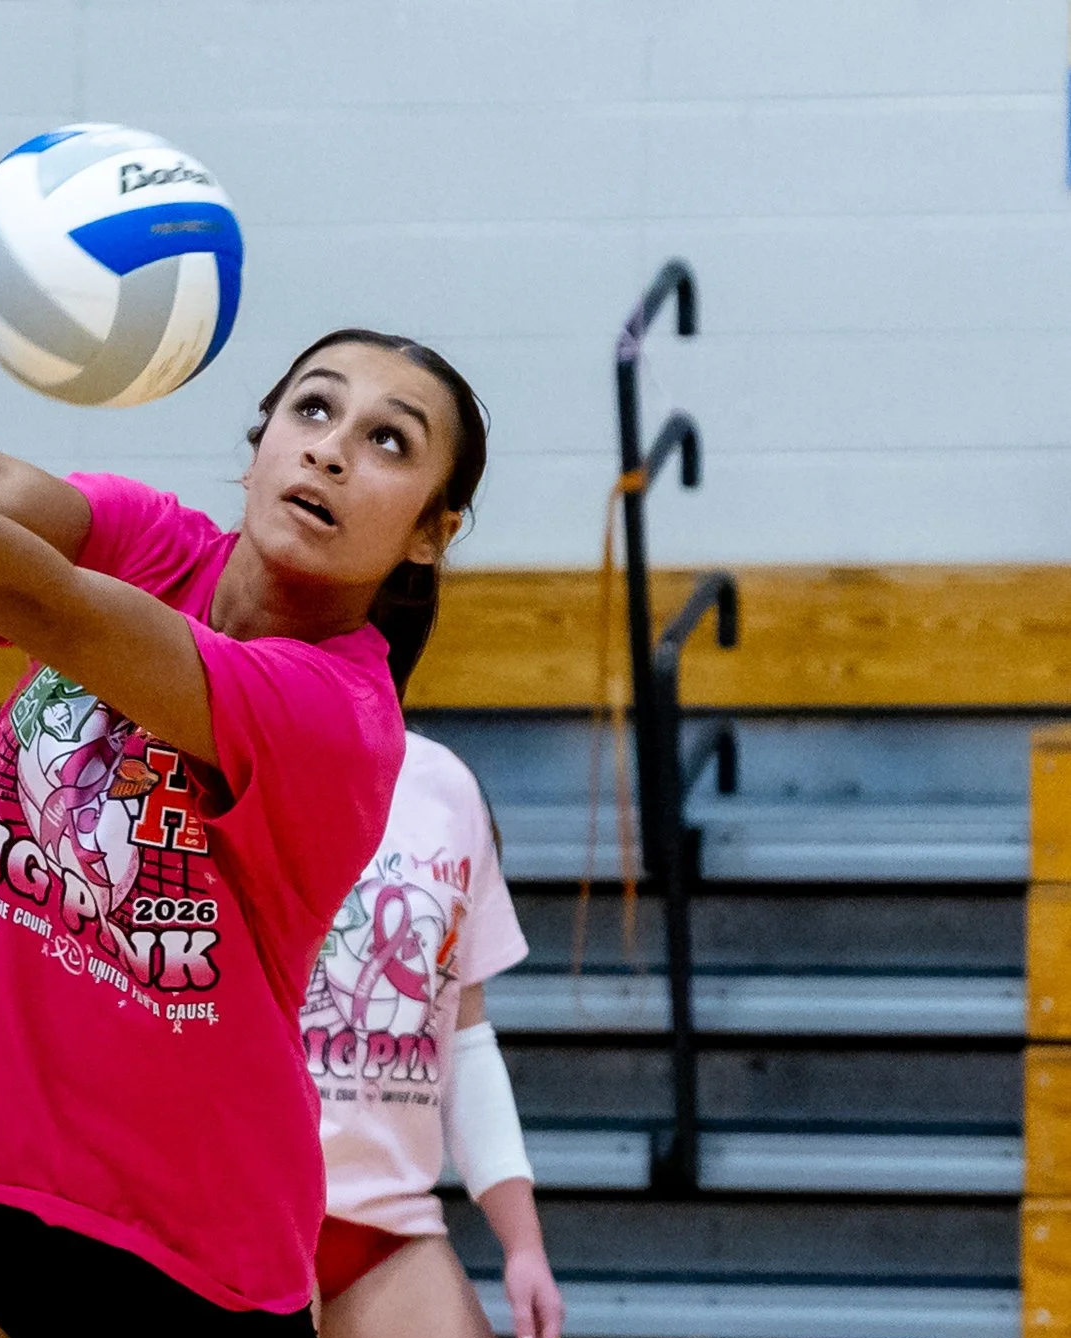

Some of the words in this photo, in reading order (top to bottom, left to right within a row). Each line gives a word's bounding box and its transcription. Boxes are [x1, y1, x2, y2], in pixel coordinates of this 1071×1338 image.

[133, 897, 218, 924] 2026
[87, 956, 129, 993] UNITED
[151, 1001, 161, 1017] A
